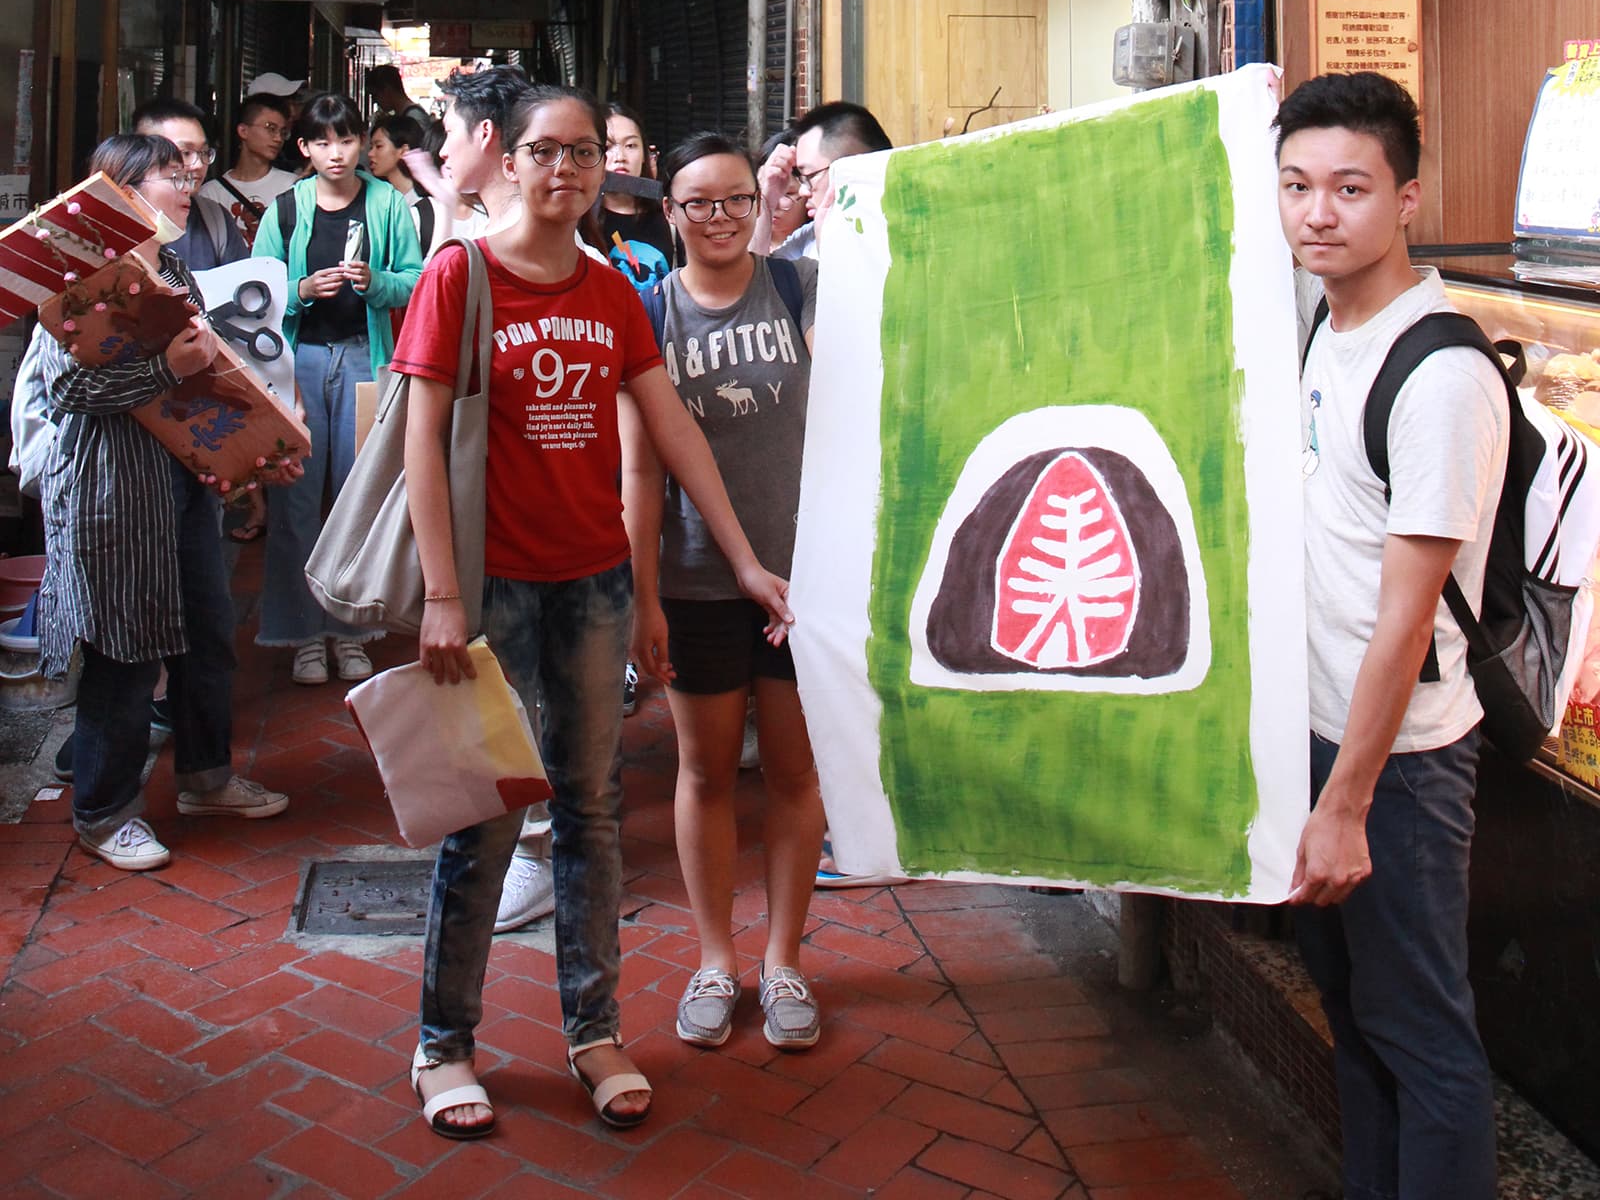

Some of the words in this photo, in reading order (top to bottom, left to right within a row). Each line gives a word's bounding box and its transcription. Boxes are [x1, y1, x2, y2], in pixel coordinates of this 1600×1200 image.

[493, 321, 538, 353] POM
[538, 316, 614, 350] POMPLUS
[531, 347, 592, 400] 97
[564, 403, 588, 411] pleasure
[589, 402, 597, 411] by
[686, 394, 706, 419] N
[769, 381, 783, 405] Y
[573, 432, 598, 441] pleasure
